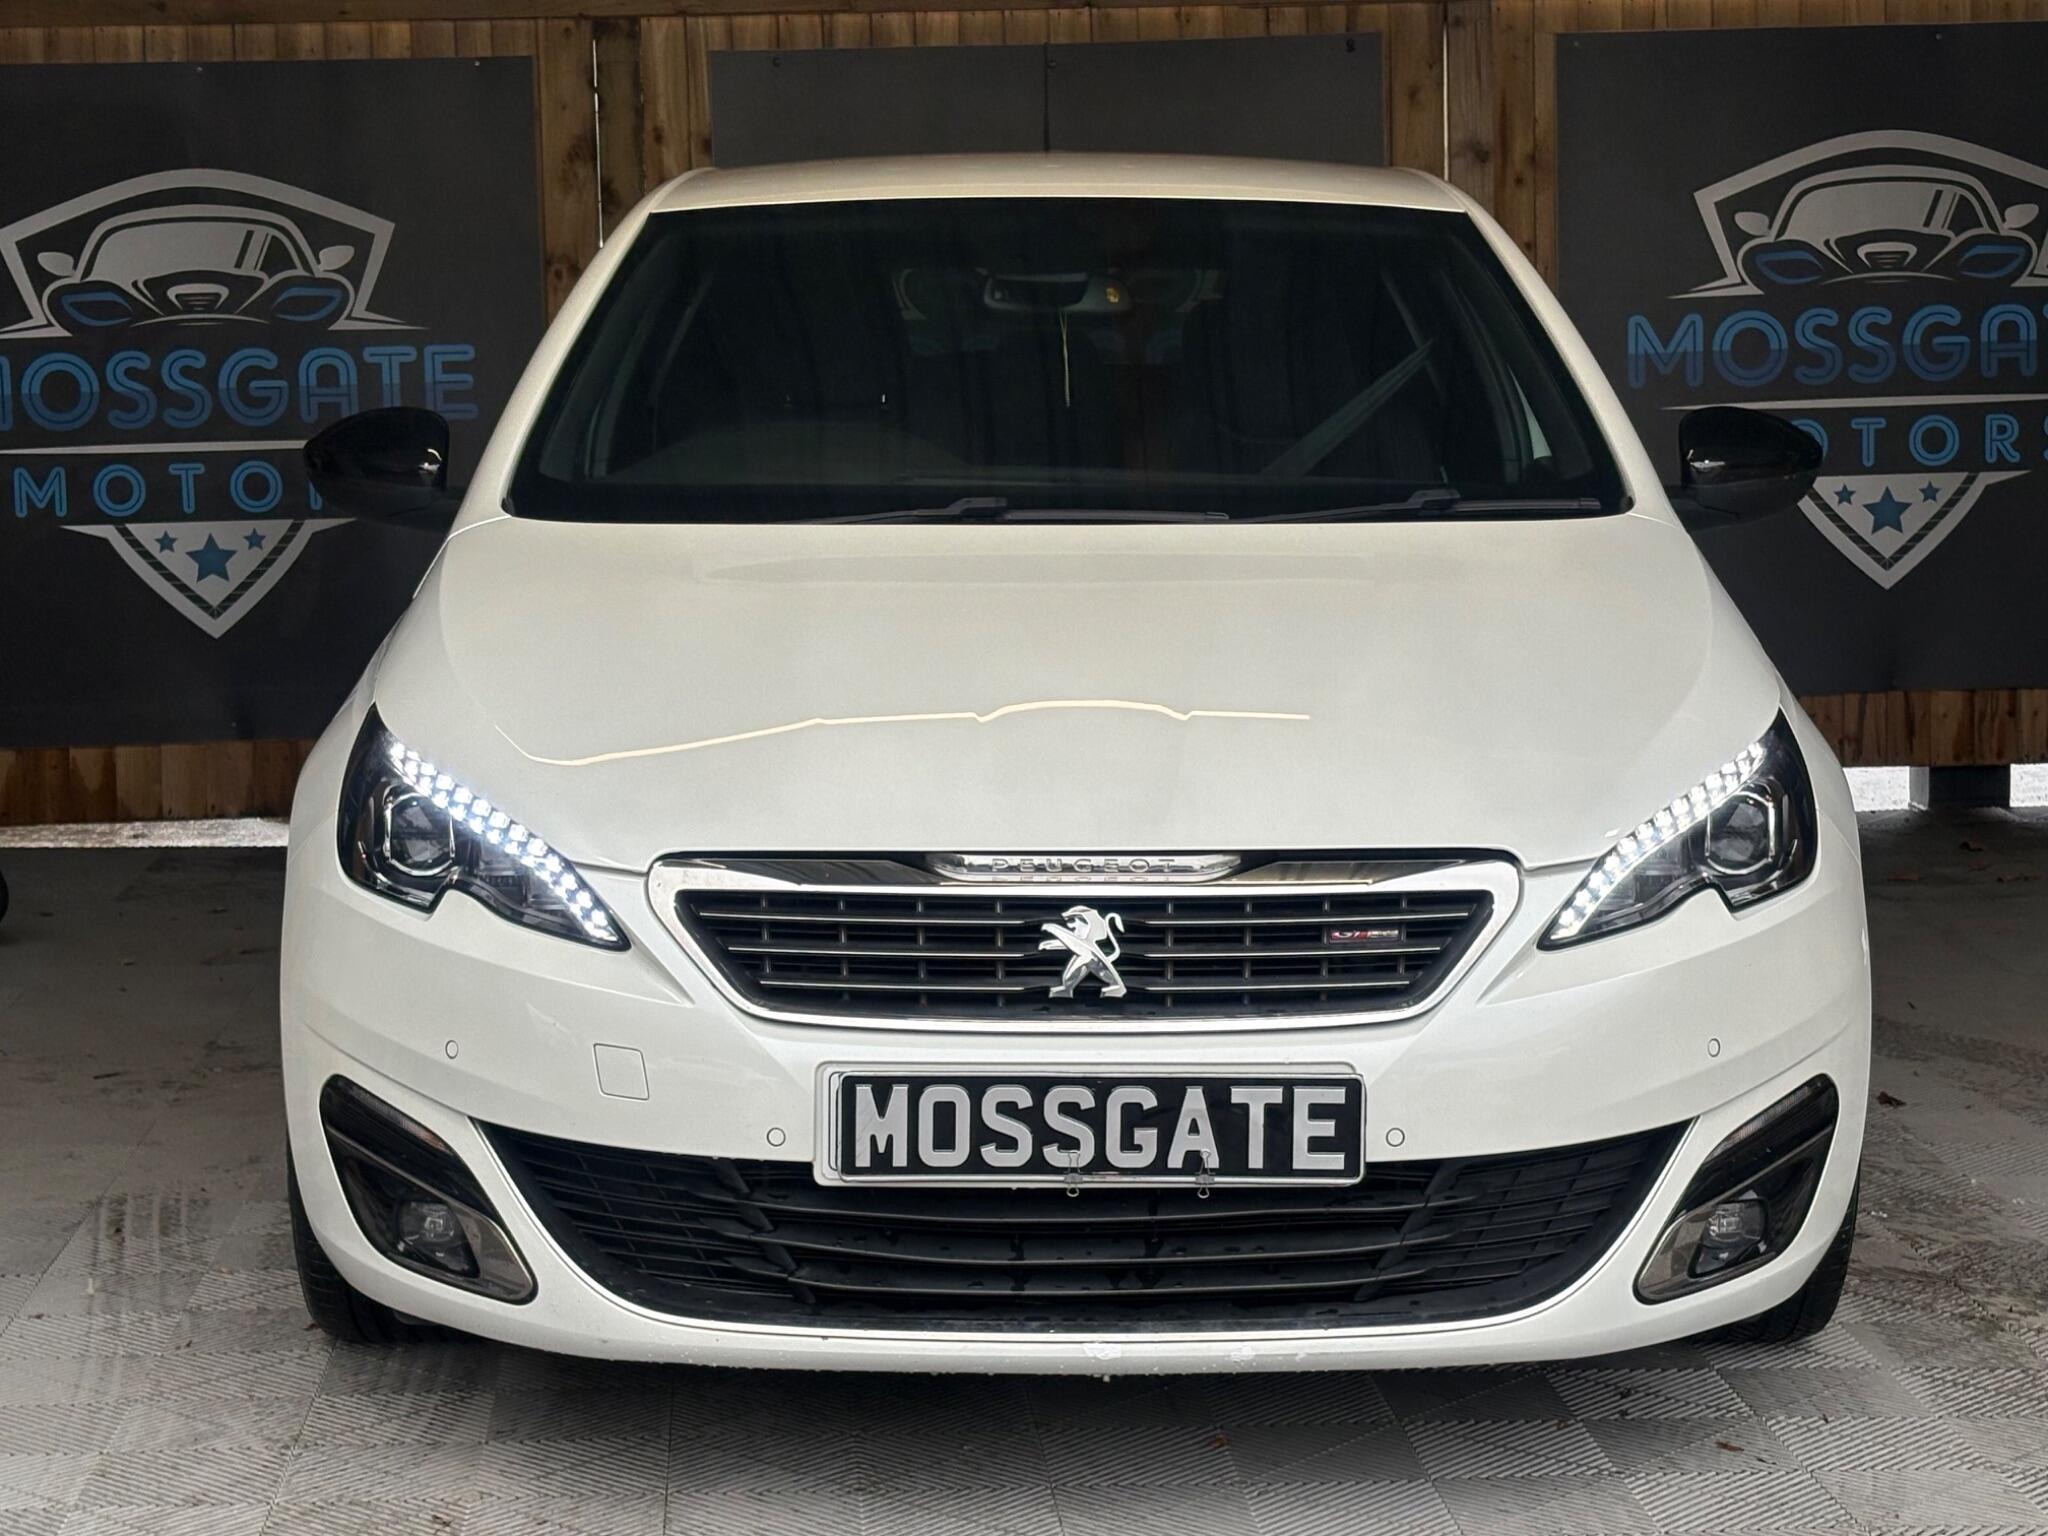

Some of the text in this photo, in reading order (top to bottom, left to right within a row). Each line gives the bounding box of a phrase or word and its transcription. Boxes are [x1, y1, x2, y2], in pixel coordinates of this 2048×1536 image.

[0, 344, 480, 431] OSSGATE
[1627, 303, 2048, 389] MOSSGA
[13, 460, 323, 518] MOTO
[991, 857, 1176, 873] PEUGEOT
[854, 1083, 1347, 1171] MOSSGATE
